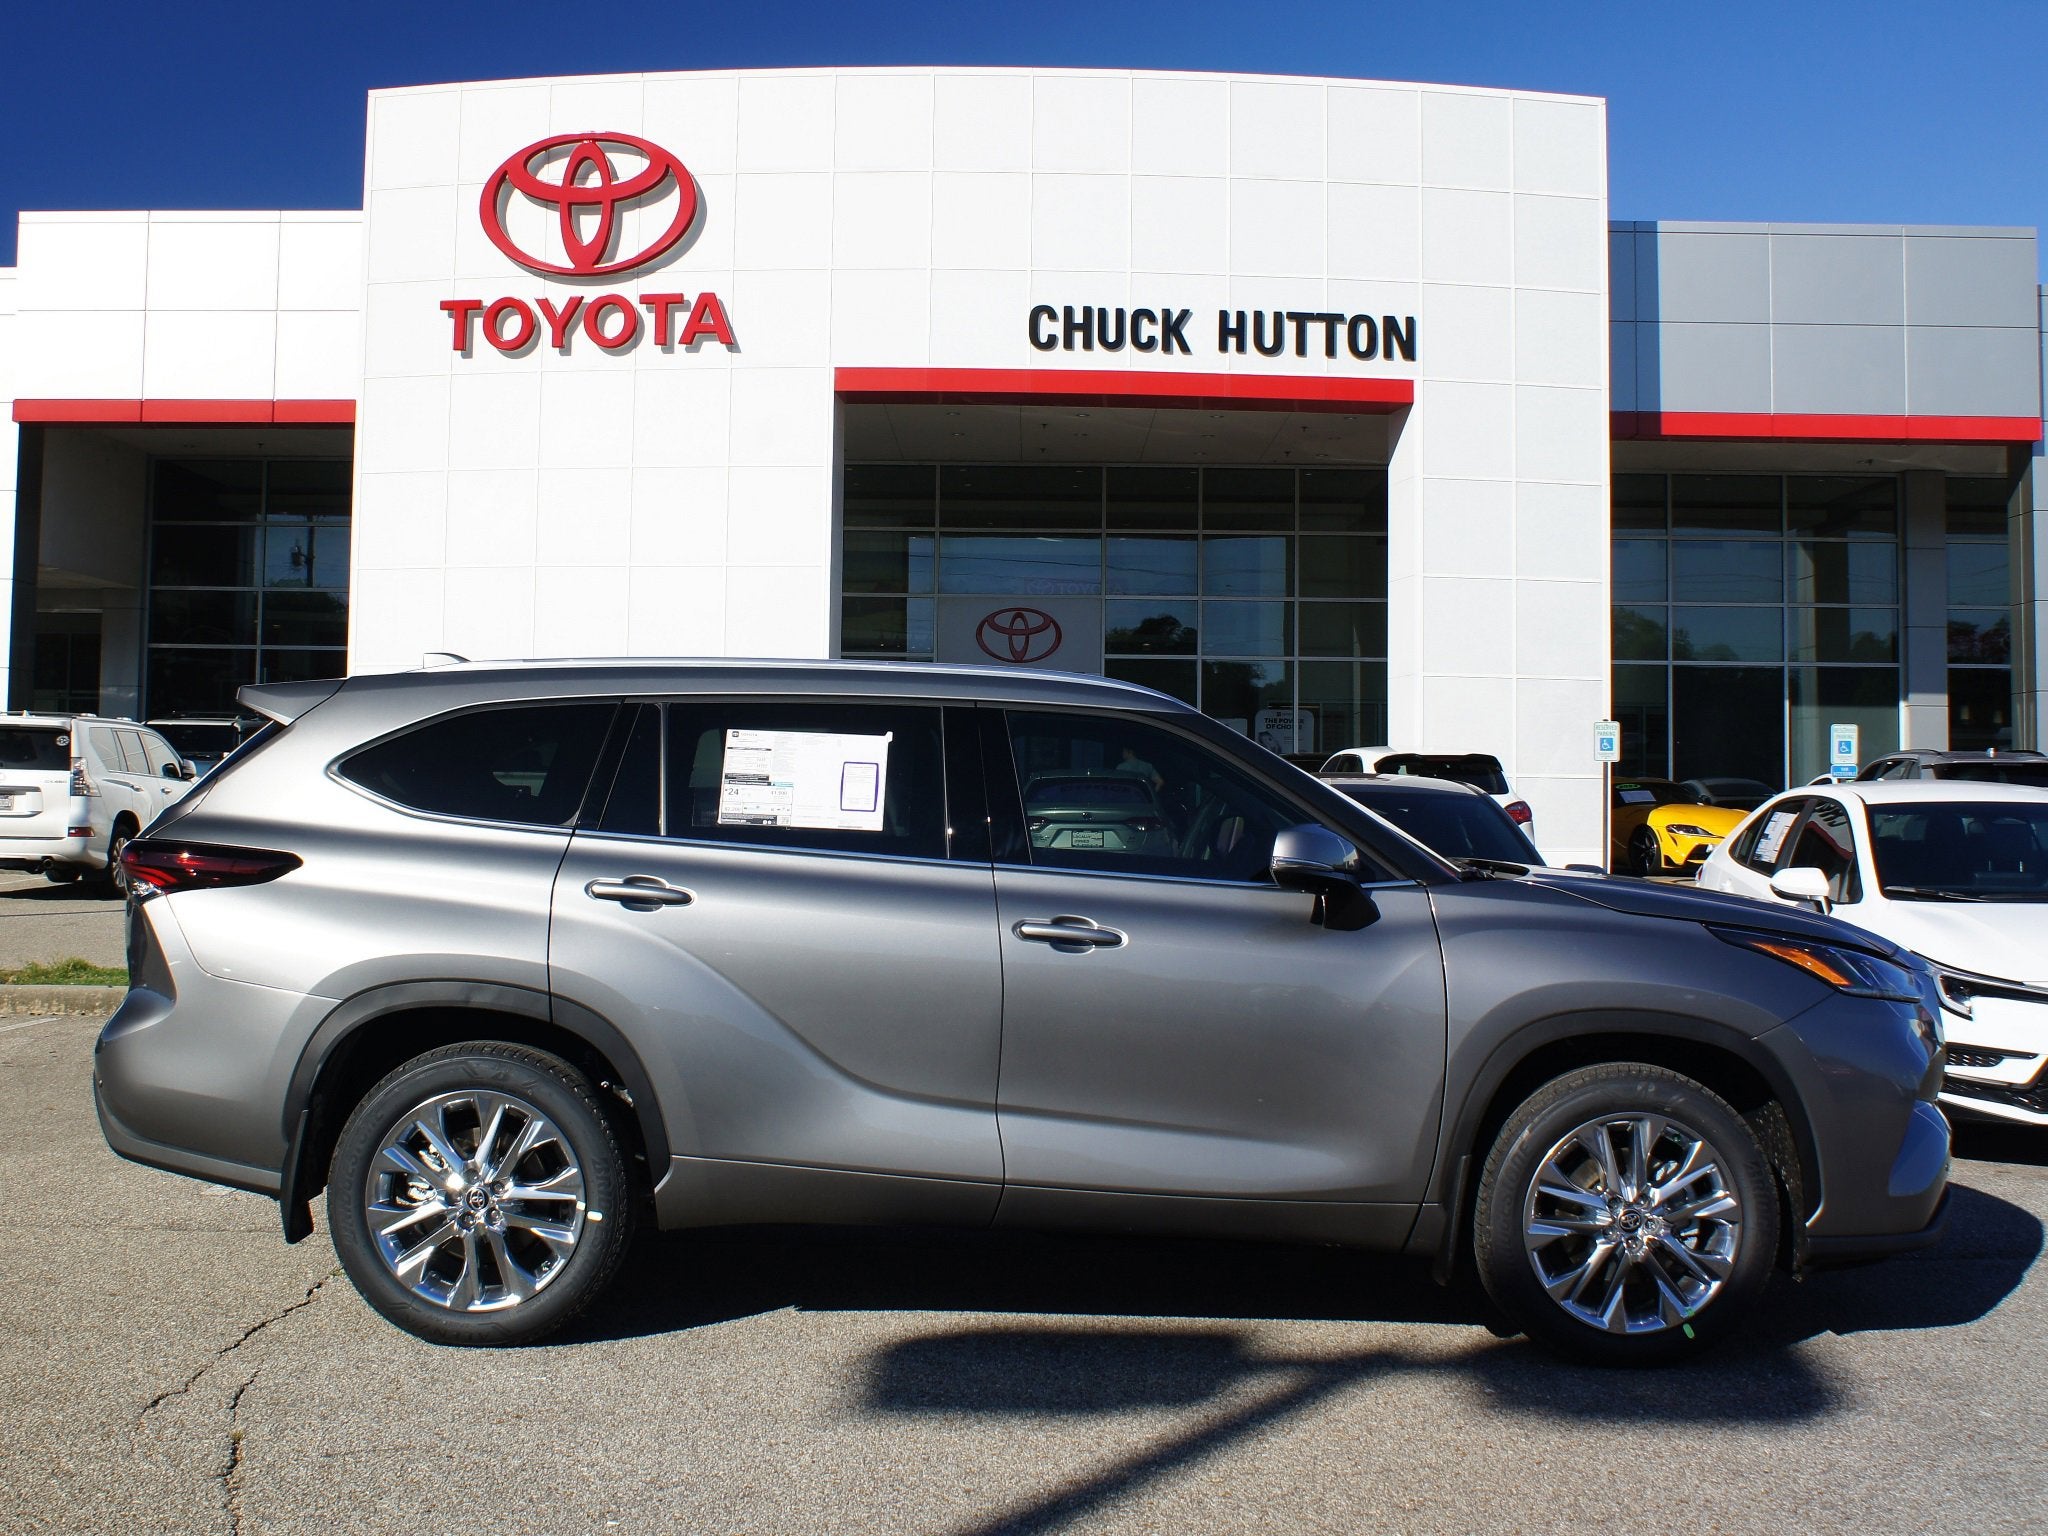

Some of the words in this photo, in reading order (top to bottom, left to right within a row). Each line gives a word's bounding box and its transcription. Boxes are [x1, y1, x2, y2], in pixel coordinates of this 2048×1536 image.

[440, 292, 735, 352] TOYOTA
[1029, 304, 1192, 355] CHUCK
[1219, 309, 1416, 362] HUTTON
[1056, 582, 1123, 595] TOYOA
[728, 788, 739, 796] 24
